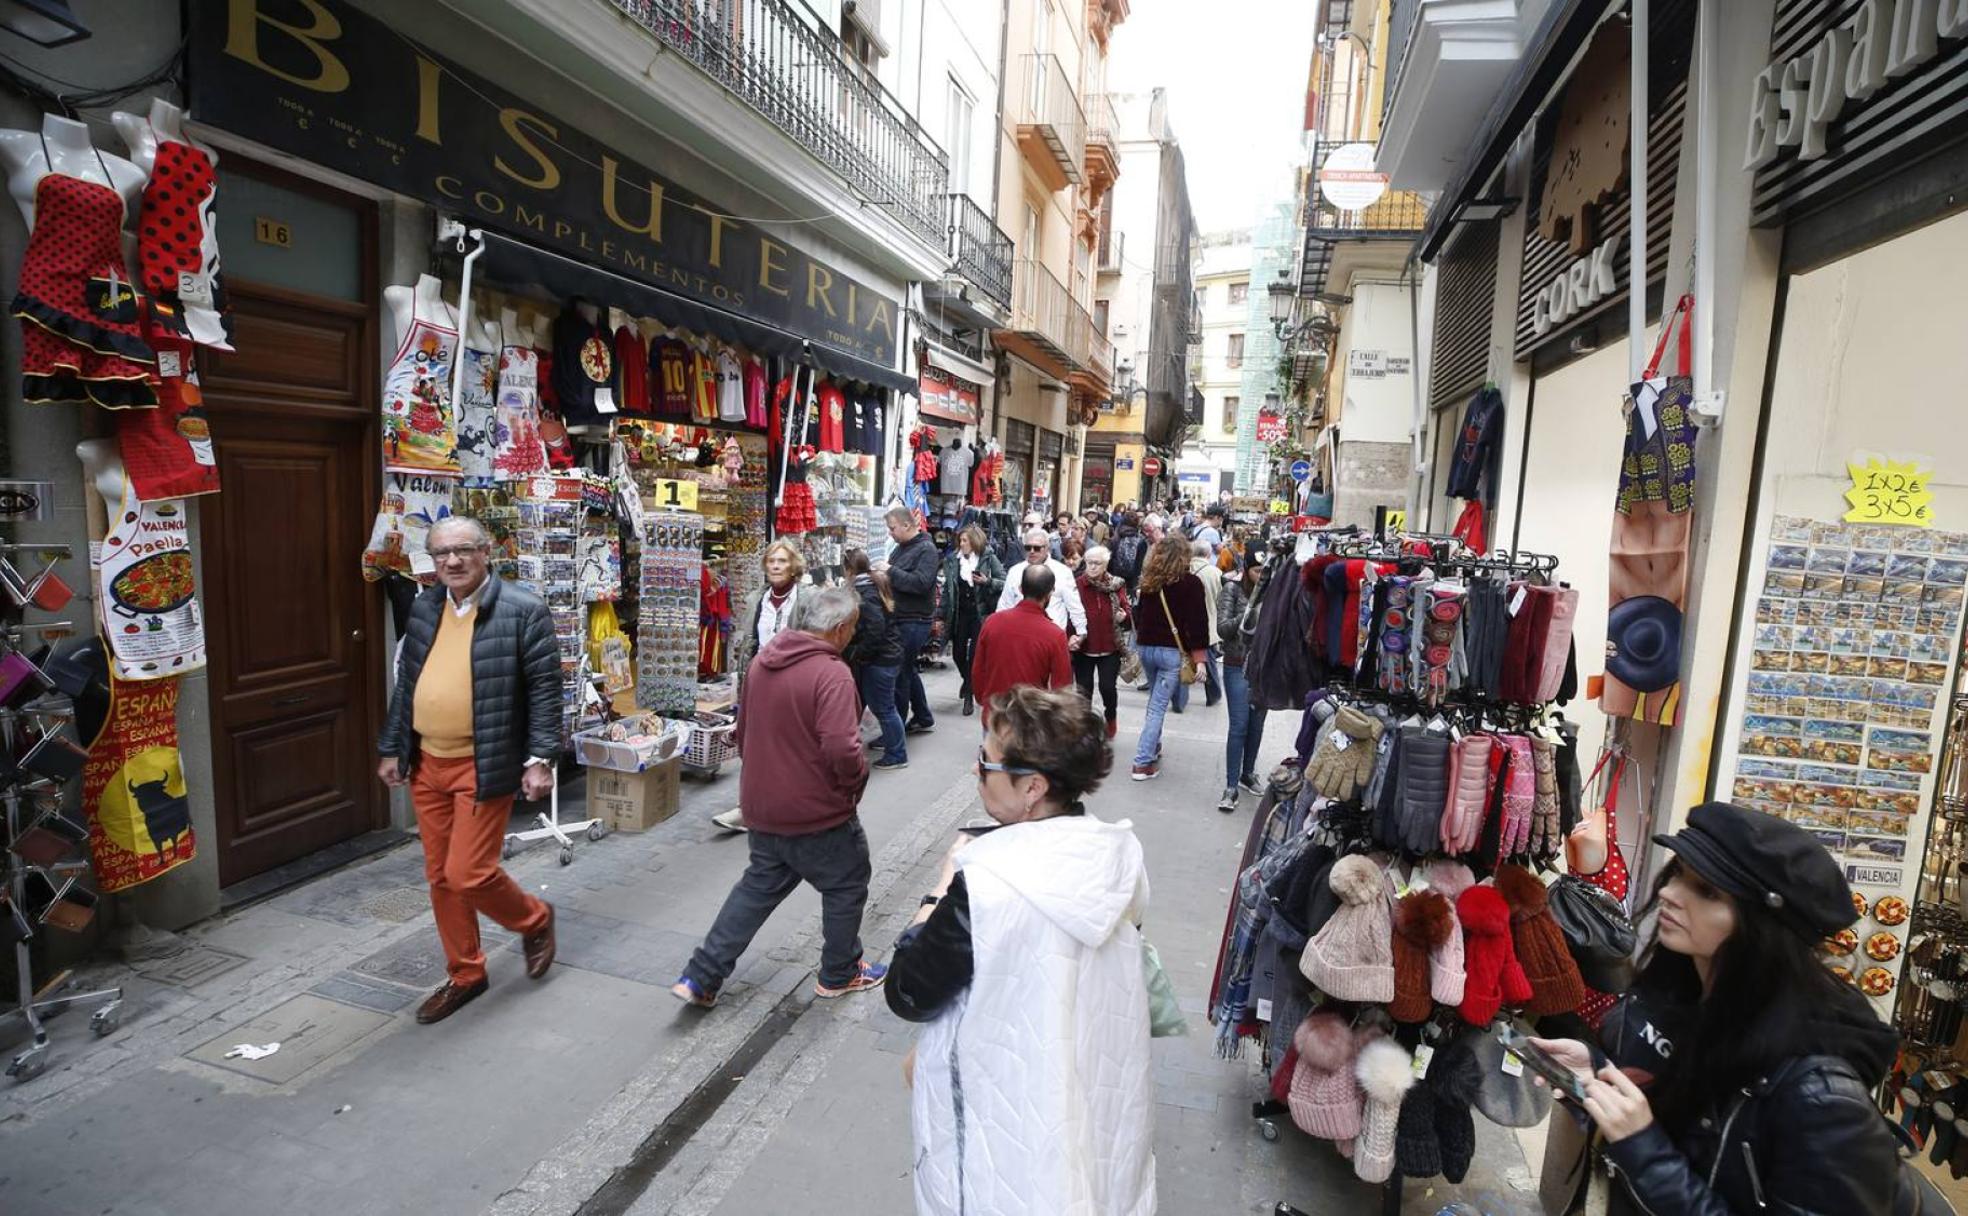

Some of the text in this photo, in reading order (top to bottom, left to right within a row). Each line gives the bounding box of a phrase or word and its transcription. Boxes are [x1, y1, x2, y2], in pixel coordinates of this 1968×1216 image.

[223, 0, 894, 342] BISUTERIA
[260, 223, 290, 244] 16
[434, 175, 746, 308] COMPLEMENTOS
[1534, 236, 1621, 335] CORK
[826, 329, 852, 345] TODO
[662, 358, 687, 394] 10
[129, 537, 183, 557] Paella
[1857, 868, 1899, 883] VALENCIA
[1639, 1020, 1674, 1059] NG
